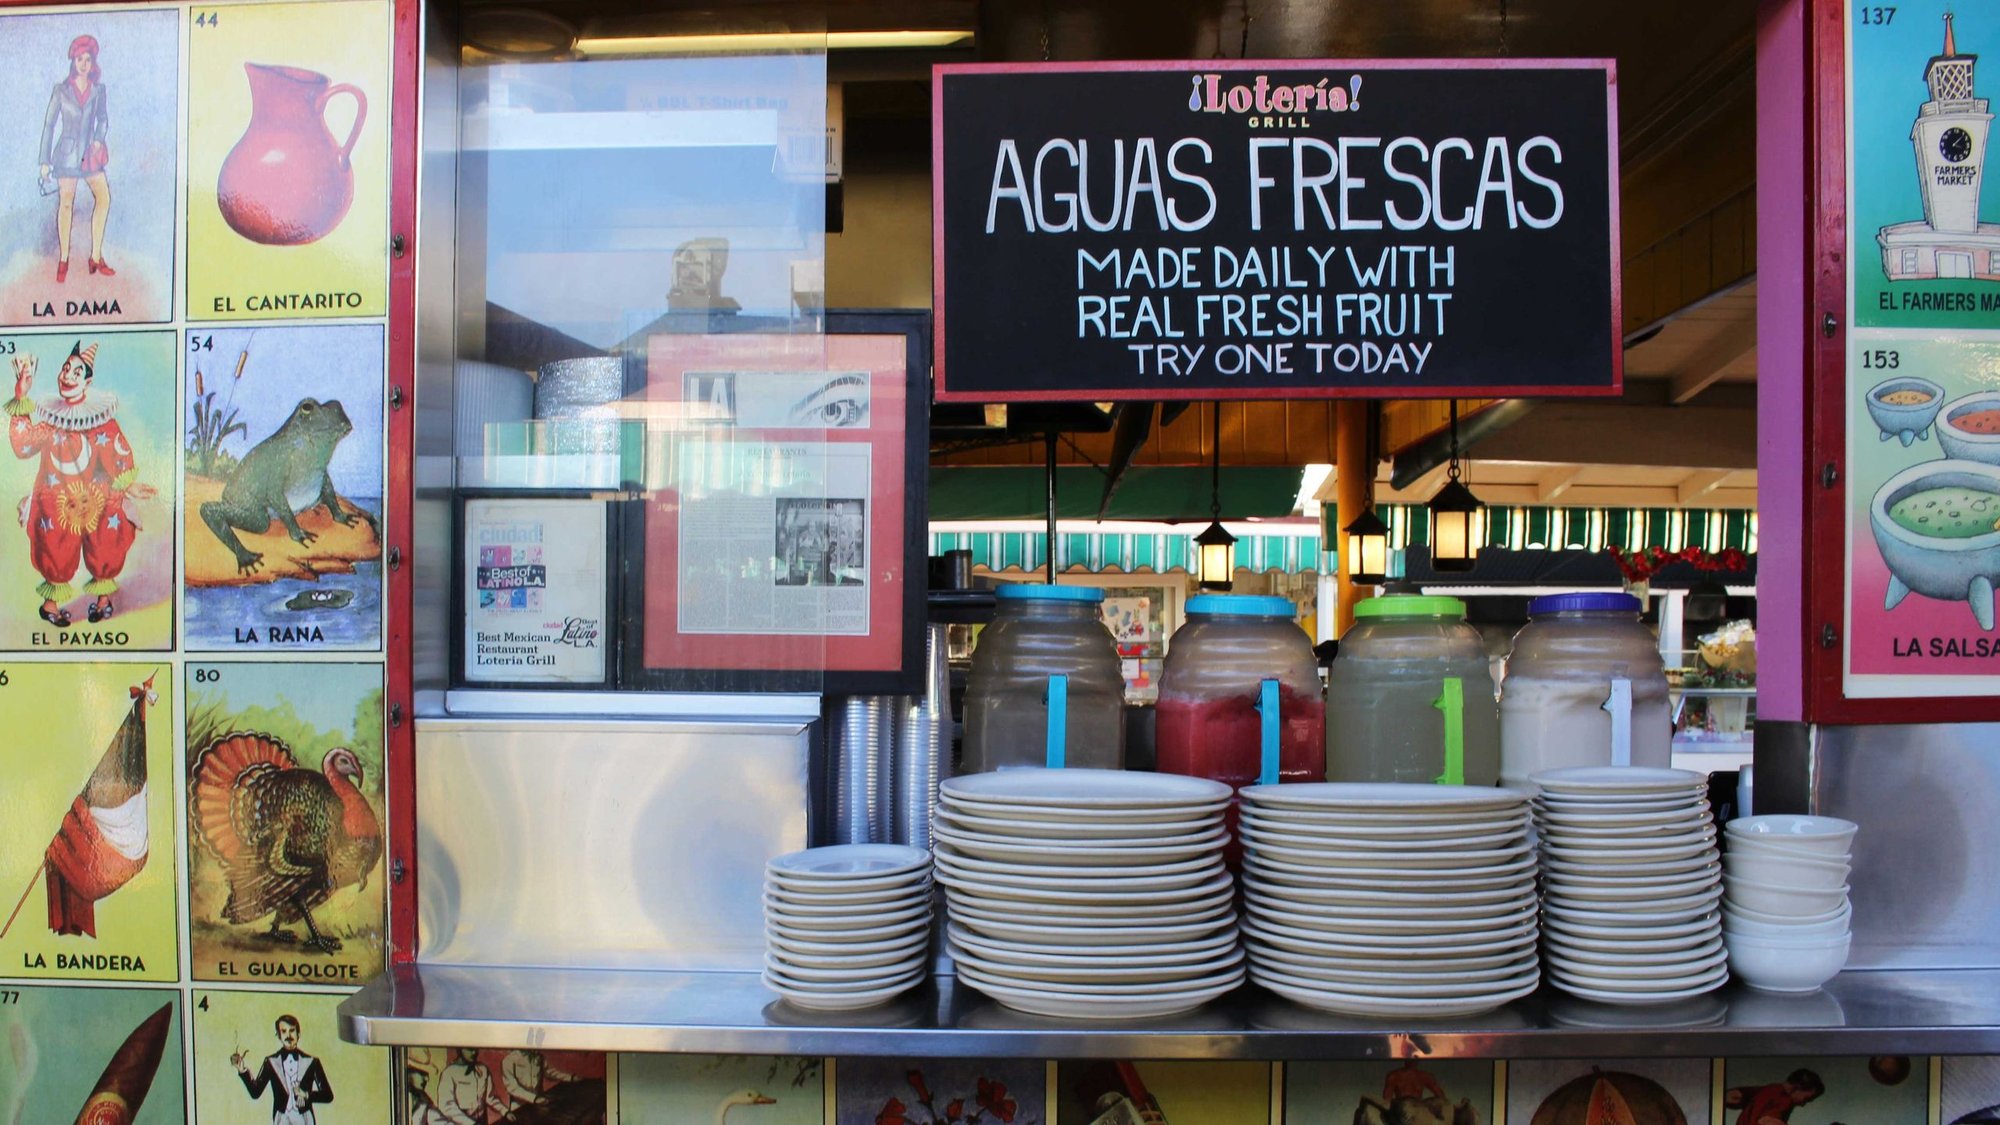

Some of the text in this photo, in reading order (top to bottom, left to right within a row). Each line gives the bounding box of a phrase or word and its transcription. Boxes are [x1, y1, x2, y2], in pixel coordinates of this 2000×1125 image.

[195, 12, 219, 28] 44
[1861, 7, 1896, 25] 137
[1188, 74, 1363, 114] ¡Lotería!
[1248, 117, 1311, 128] GRILL
[1934, 165, 1977, 176] FARMERS
[986, 136, 1564, 233] AGUAS FRESCAS
[1937, 175, 1974, 186] MARKET
[1077, 245, 1455, 289] MADE DAILY WITH
[32, 300, 122, 317] LA DAMA
[213, 292, 362, 312] EL CANTARITO
[1879, 292, 1898, 311] EL
[1902, 292, 1976, 311] FARMERS
[1078, 294, 1452, 338] REAL FRESH FRUIT
[191, 336, 214, 352] 54
[1128, 342, 1432, 375] TRY ONE TODAY
[1863, 350, 1900, 369] 153
[491, 565, 531, 580] Best of
[479, 577, 523, 588] LATINO
[32, 632, 129, 646] EL PAYASO
[235, 627, 325, 644] LA RANA
[477, 632, 551, 642] Best Mexican
[477, 643, 538, 654] Restaurant
[1893, 637, 2000, 657] LA SALSA
[526, 655, 556, 666] Grill
[195, 669, 220, 683] 80
[24, 953, 146, 972] LA BANDERA
[218, 962, 358, 979] EL GUAJOLOTE
[1, 990, 20, 1005] 77
[198, 997, 210, 1012] 4
